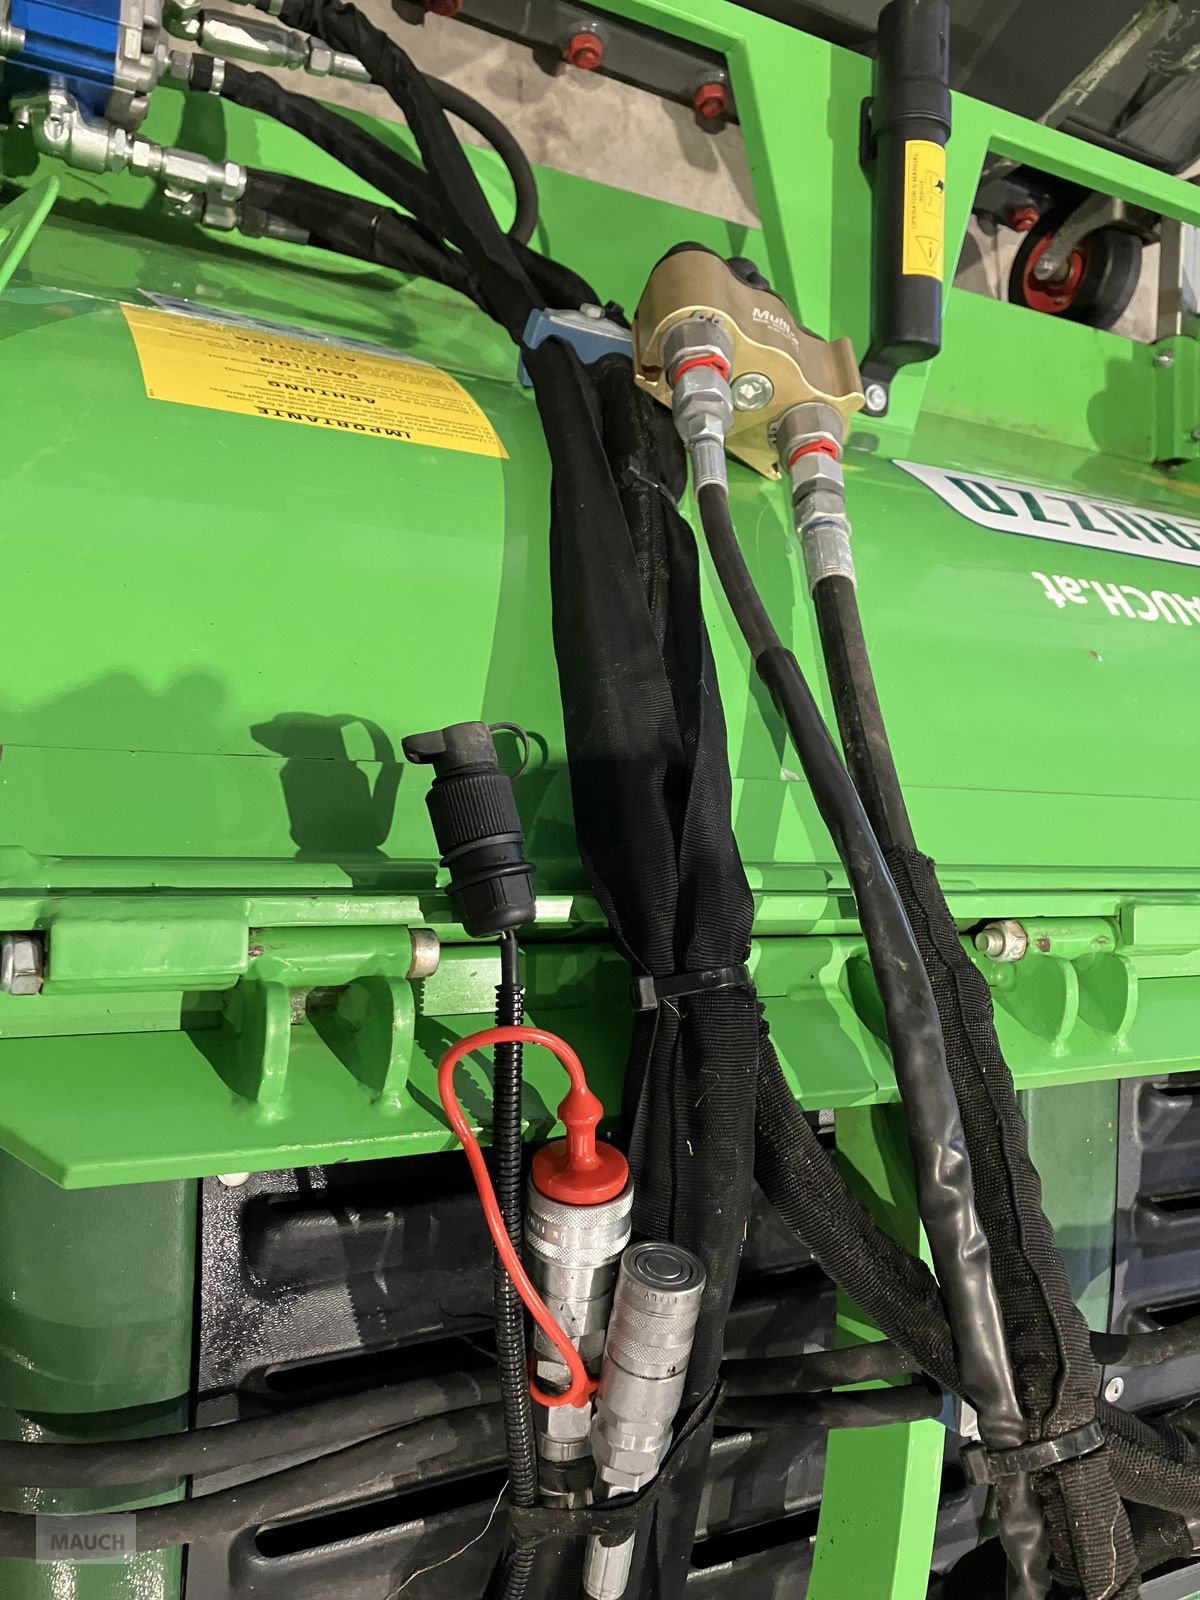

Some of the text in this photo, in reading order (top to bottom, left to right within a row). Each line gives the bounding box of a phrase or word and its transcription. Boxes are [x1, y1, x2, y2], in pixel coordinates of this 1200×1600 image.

[260, 357, 359, 380] CAUTION
[266, 380, 376, 405] ACHTUNG
[254, 407, 411, 440] IMPORTANTE
